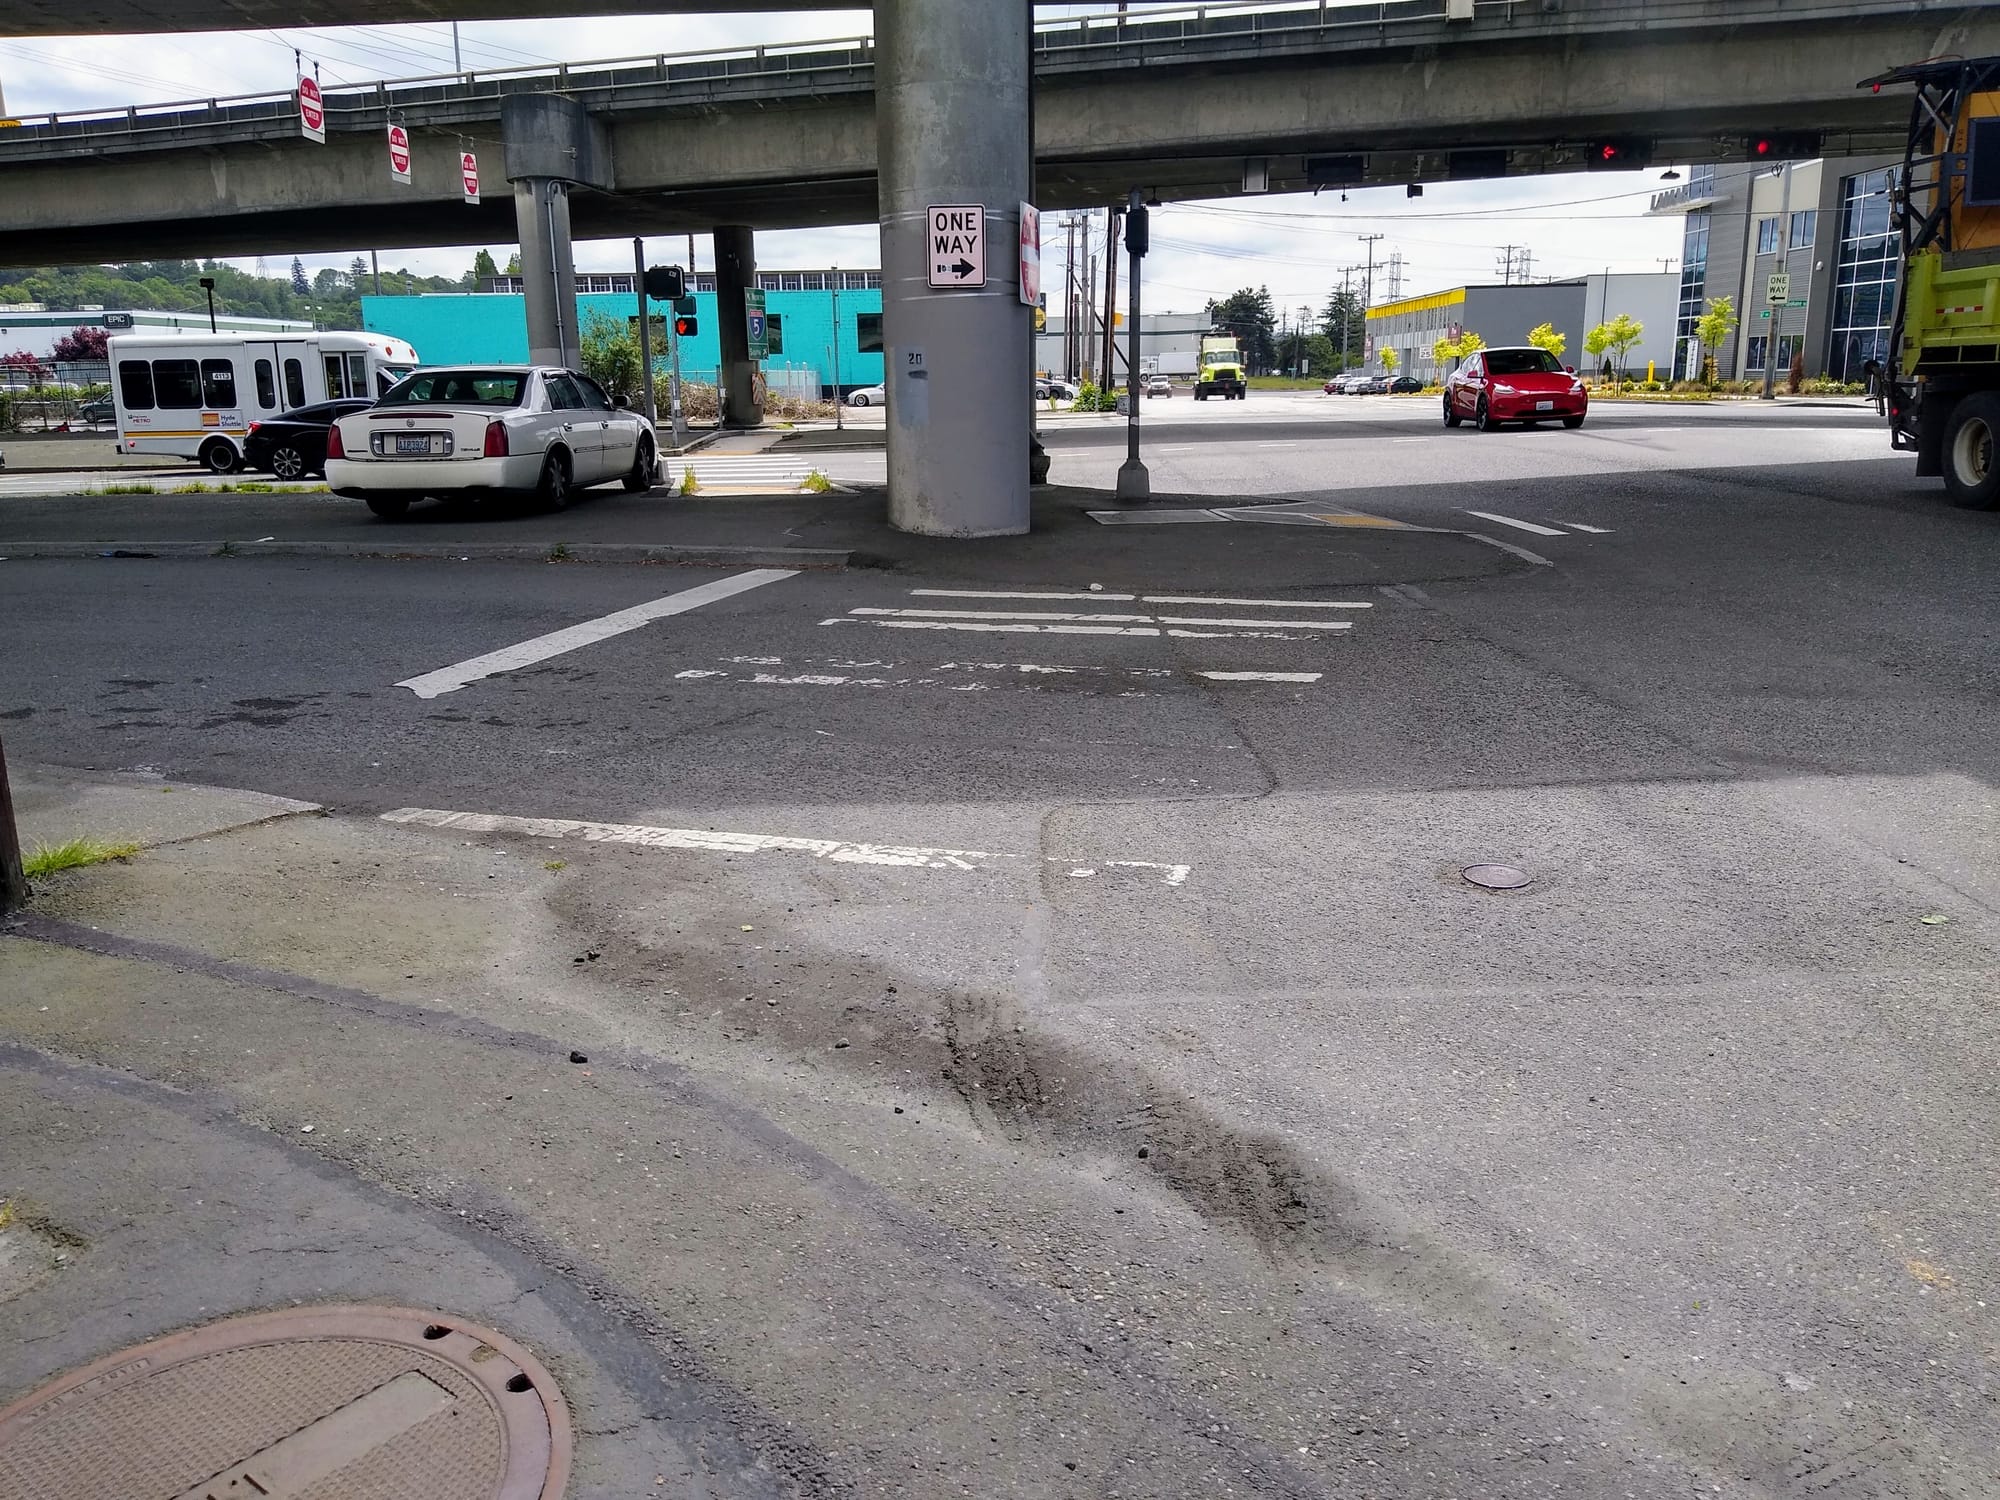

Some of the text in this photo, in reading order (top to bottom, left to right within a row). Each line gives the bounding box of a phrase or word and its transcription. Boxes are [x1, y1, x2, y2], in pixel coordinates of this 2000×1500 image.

[310, 88, 319, 99] NOT
[305, 109, 319, 121] ENTER
[395, 155, 406, 164] ENTER
[935, 212, 977, 232] ONE
[934, 235, 978, 254] WAY
[1770, 276, 1788, 285] ONE
[107, 314, 126, 323] EPIC
[753, 319, 760, 335] 5
